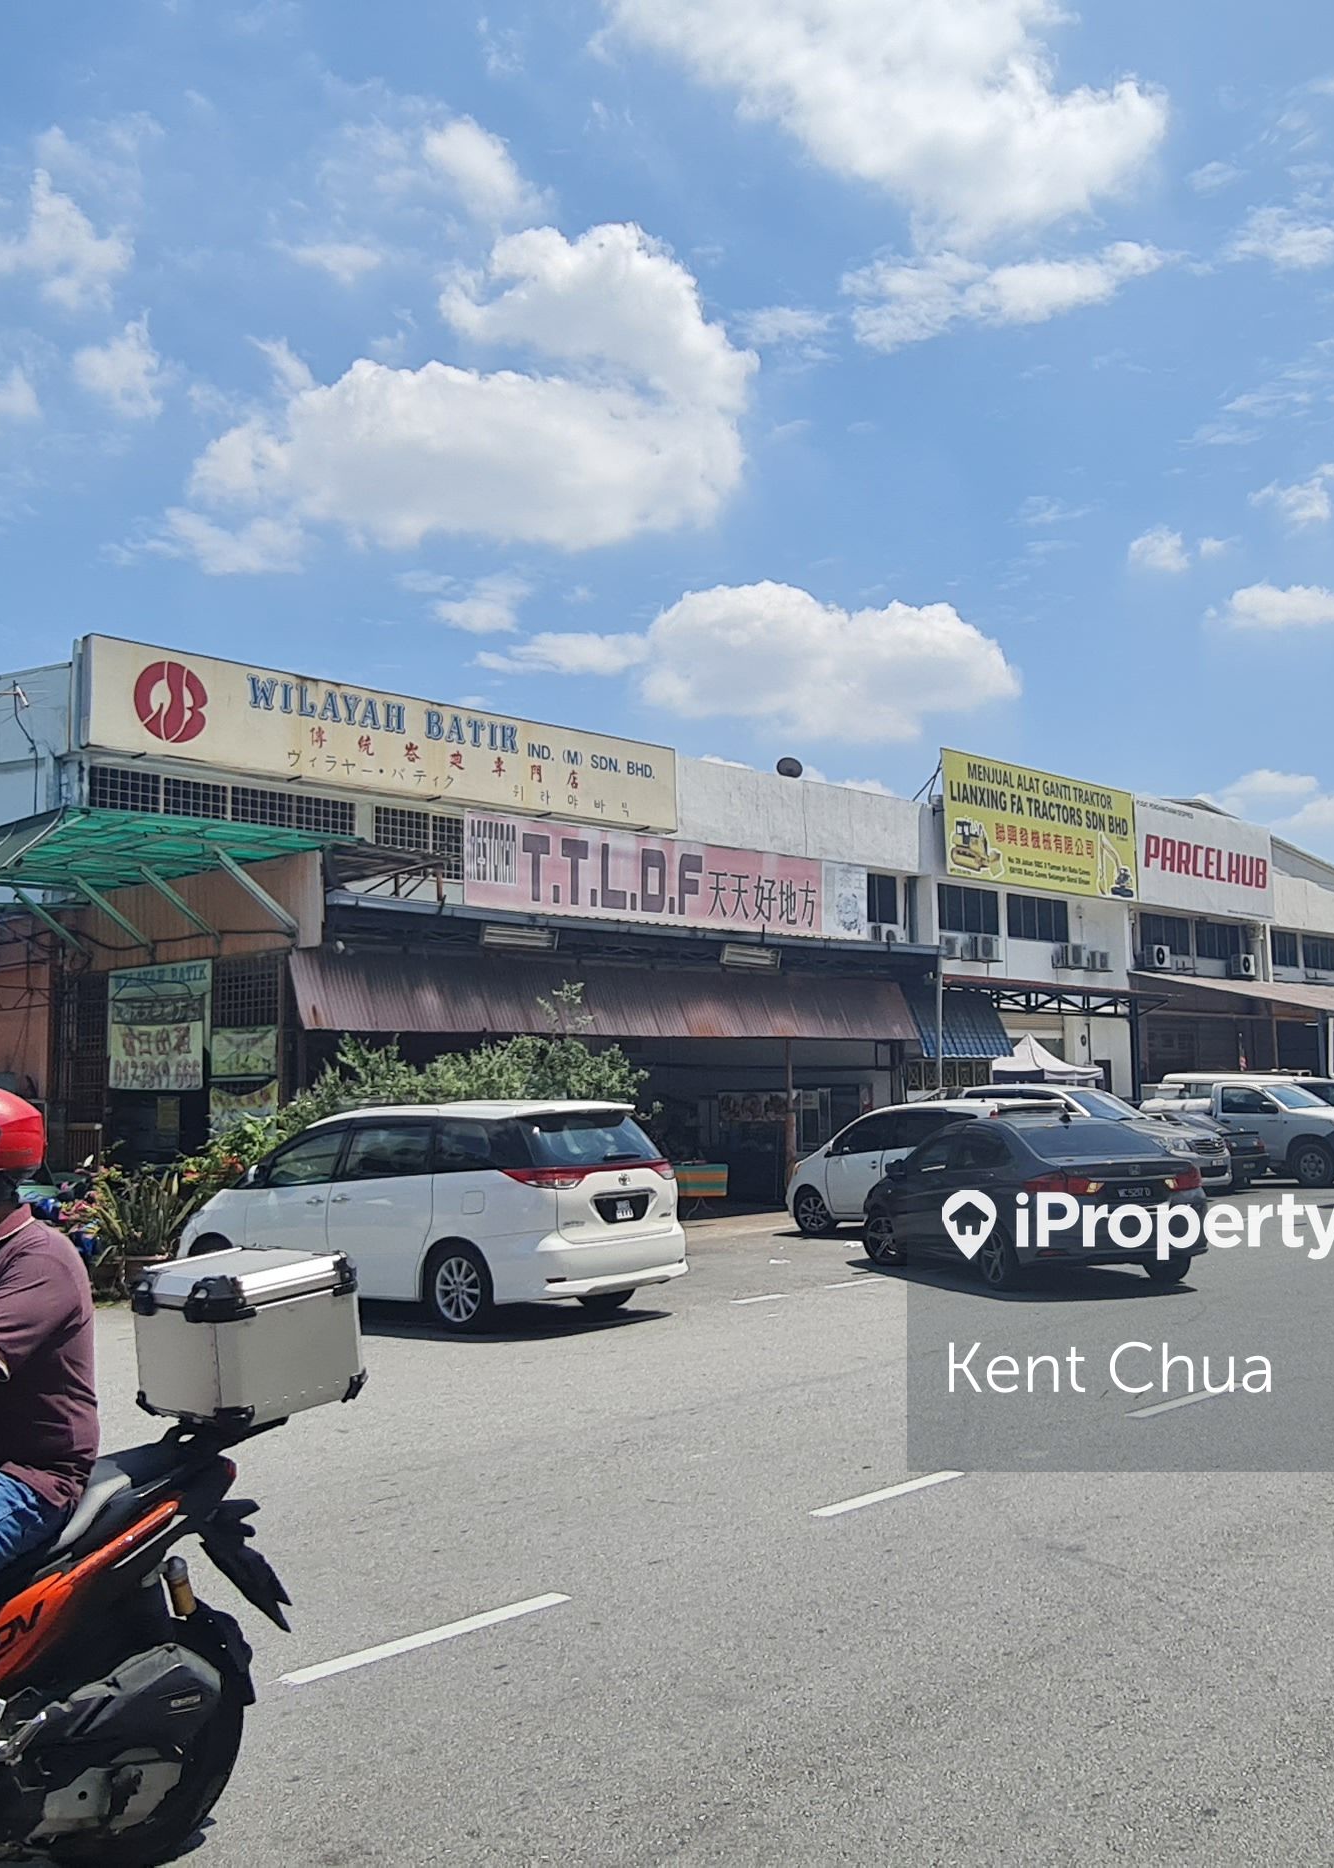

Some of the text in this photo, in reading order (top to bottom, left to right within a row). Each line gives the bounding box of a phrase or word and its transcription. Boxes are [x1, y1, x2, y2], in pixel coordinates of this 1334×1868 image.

[247, 673, 656, 780] WILAYAH BATIK IND. (M) SDN. BHD.
[949, 780, 1129, 837] LIANXING FA TRACTORS SDN BHD
[967, 762, 1015, 788] MENJUAL
[1018, 774, 1040, 794] ALAT
[1043, 780, 1072, 802] GANTI
[1073, 787, 1113, 811] TRAKTOR
[522, 832, 703, 916] T.T.L.D.F
[1144, 833, 1268, 890] PARCELHUB
[708, 872, 817, 928] 天天好地方
